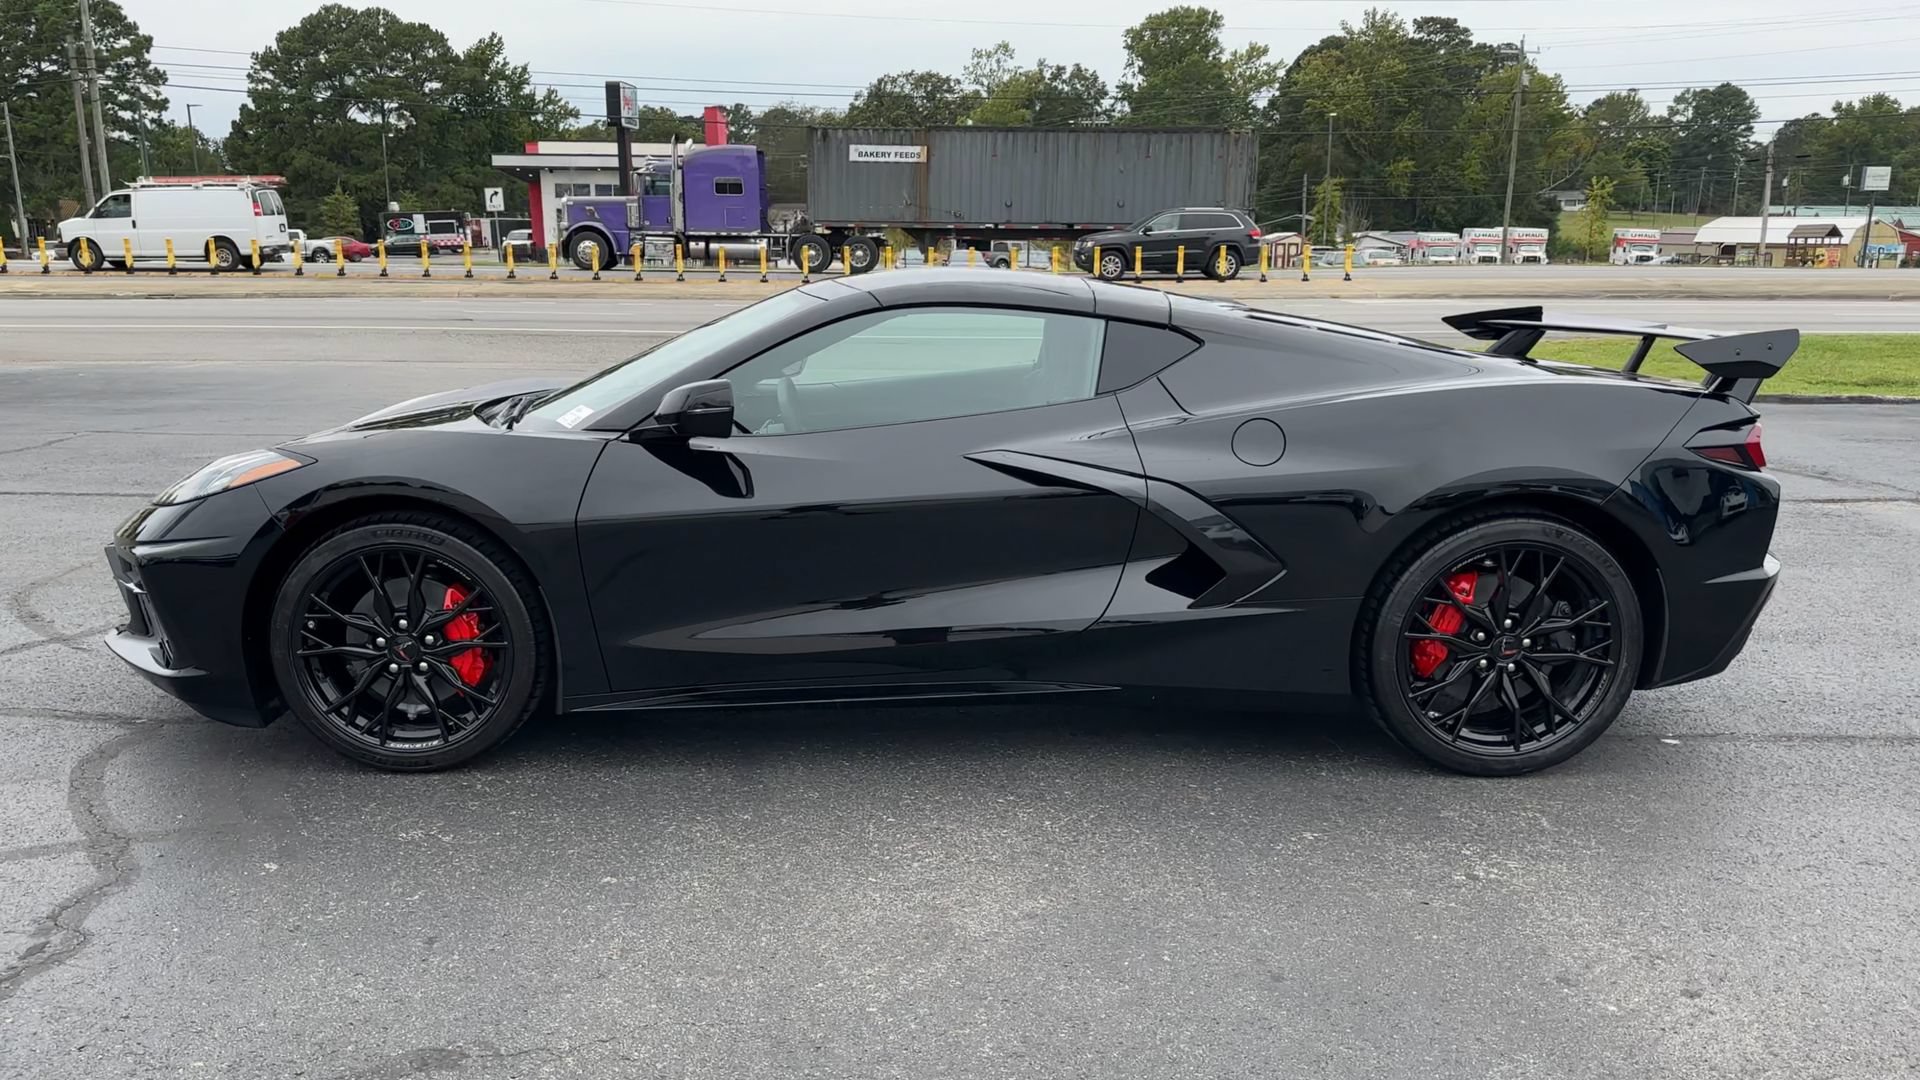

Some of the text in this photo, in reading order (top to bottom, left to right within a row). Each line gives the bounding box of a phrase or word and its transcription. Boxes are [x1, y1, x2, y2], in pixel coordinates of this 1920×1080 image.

[857, 150, 921, 159] BAKERY FEEDS
[389, 739, 439, 749] CORVETTE
